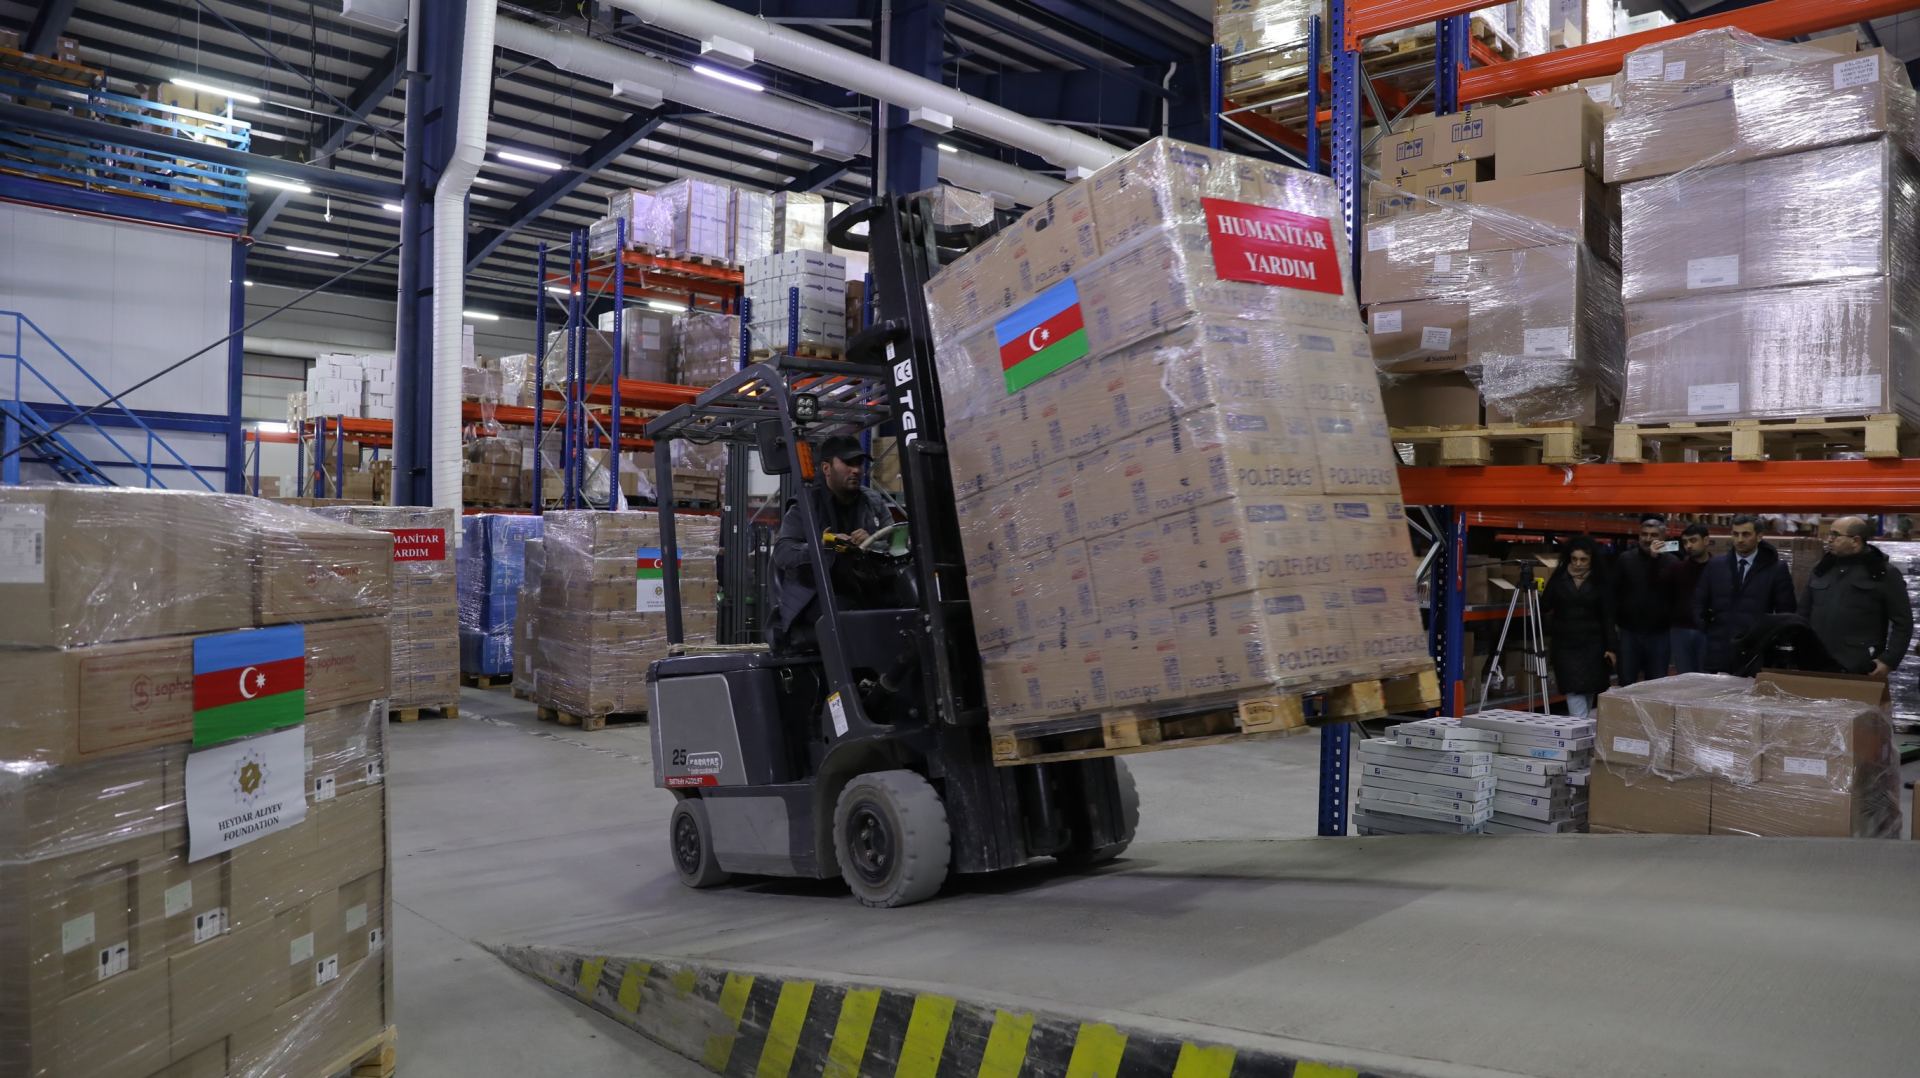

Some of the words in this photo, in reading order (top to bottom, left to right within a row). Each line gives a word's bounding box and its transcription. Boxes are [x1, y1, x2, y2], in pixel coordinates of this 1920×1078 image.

[1216, 214, 1327, 250] HUMANİTAR
[1244, 251, 1317, 281] YARDIM
[394, 548, 429, 558] ARDIM
[672, 748, 687, 766] 25
[218, 811, 254, 832] HEYDAR
[254, 802, 283, 819] ALIYEV
[223, 816, 280, 842] FOUNDATION
